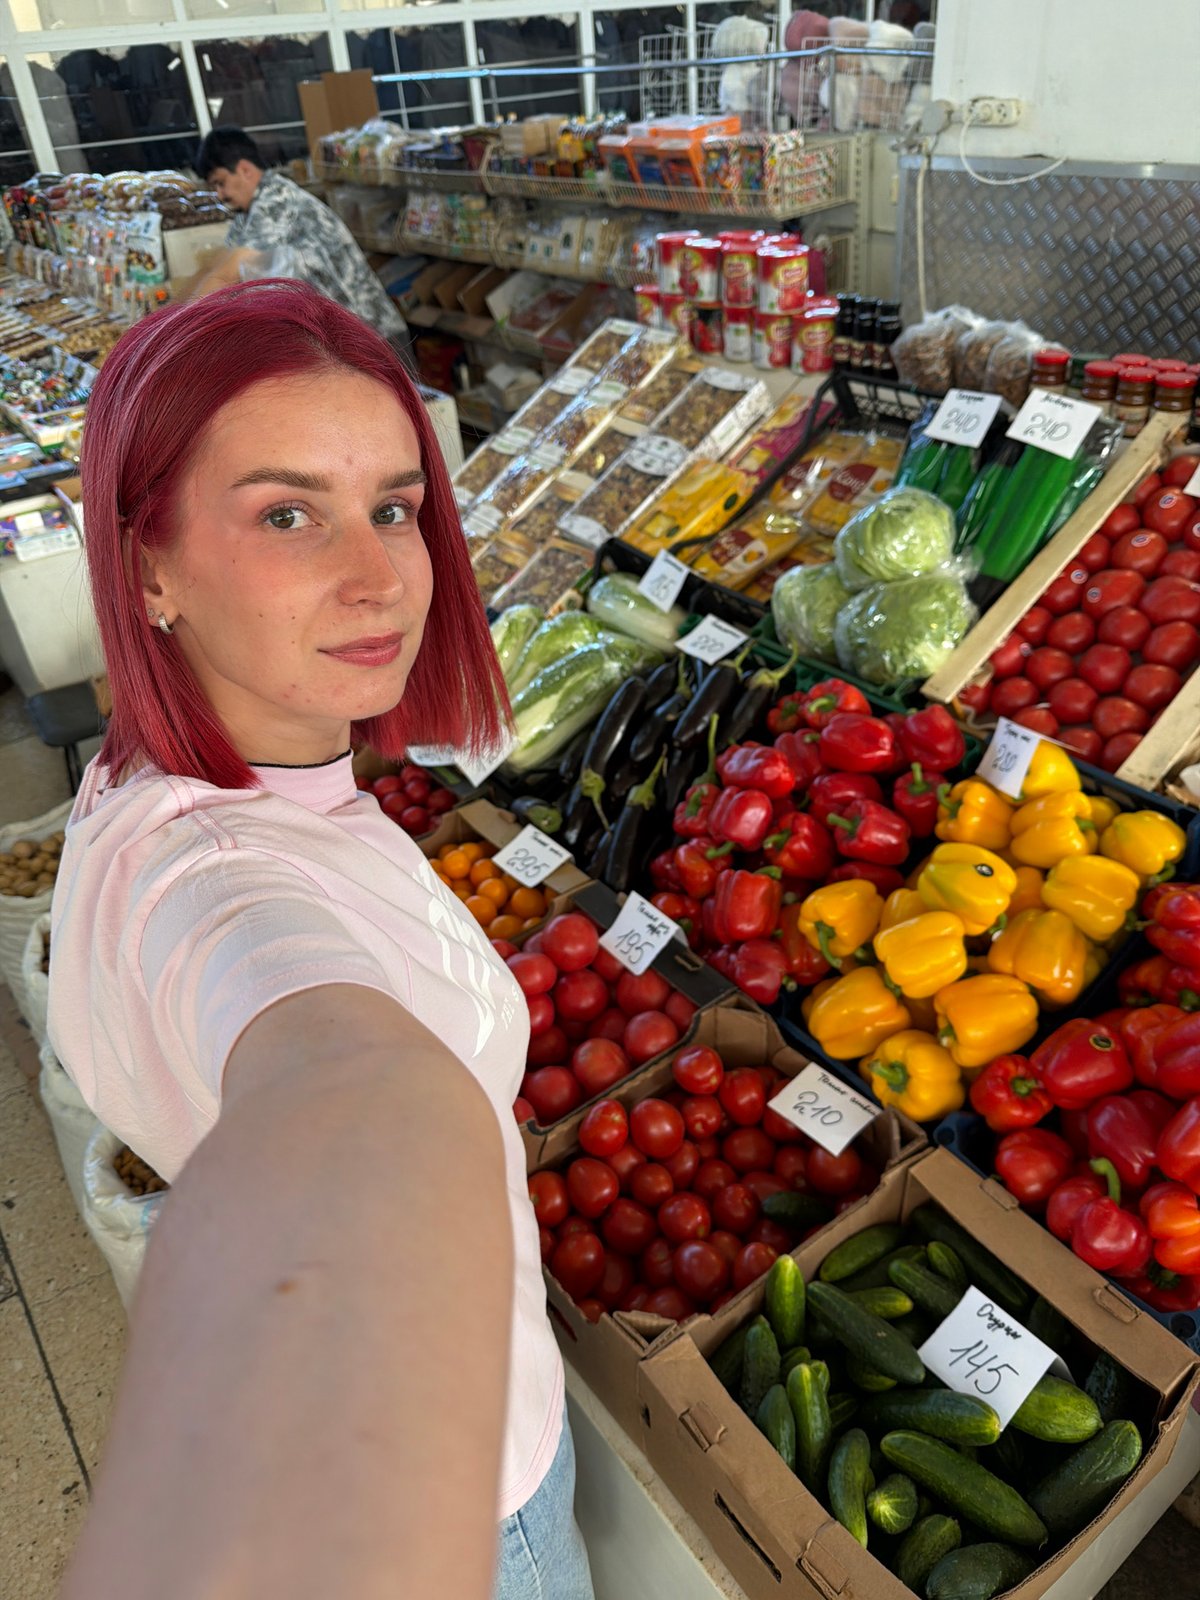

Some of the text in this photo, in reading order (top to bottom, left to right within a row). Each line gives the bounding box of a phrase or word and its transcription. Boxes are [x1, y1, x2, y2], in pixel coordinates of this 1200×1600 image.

[1023, 412, 1072, 441] 240
[507, 848, 550, 878] 295
[615, 929, 655, 965] 195
[792, 1090, 844, 1126] 210
[949, 1340, 1020, 1395] 145
